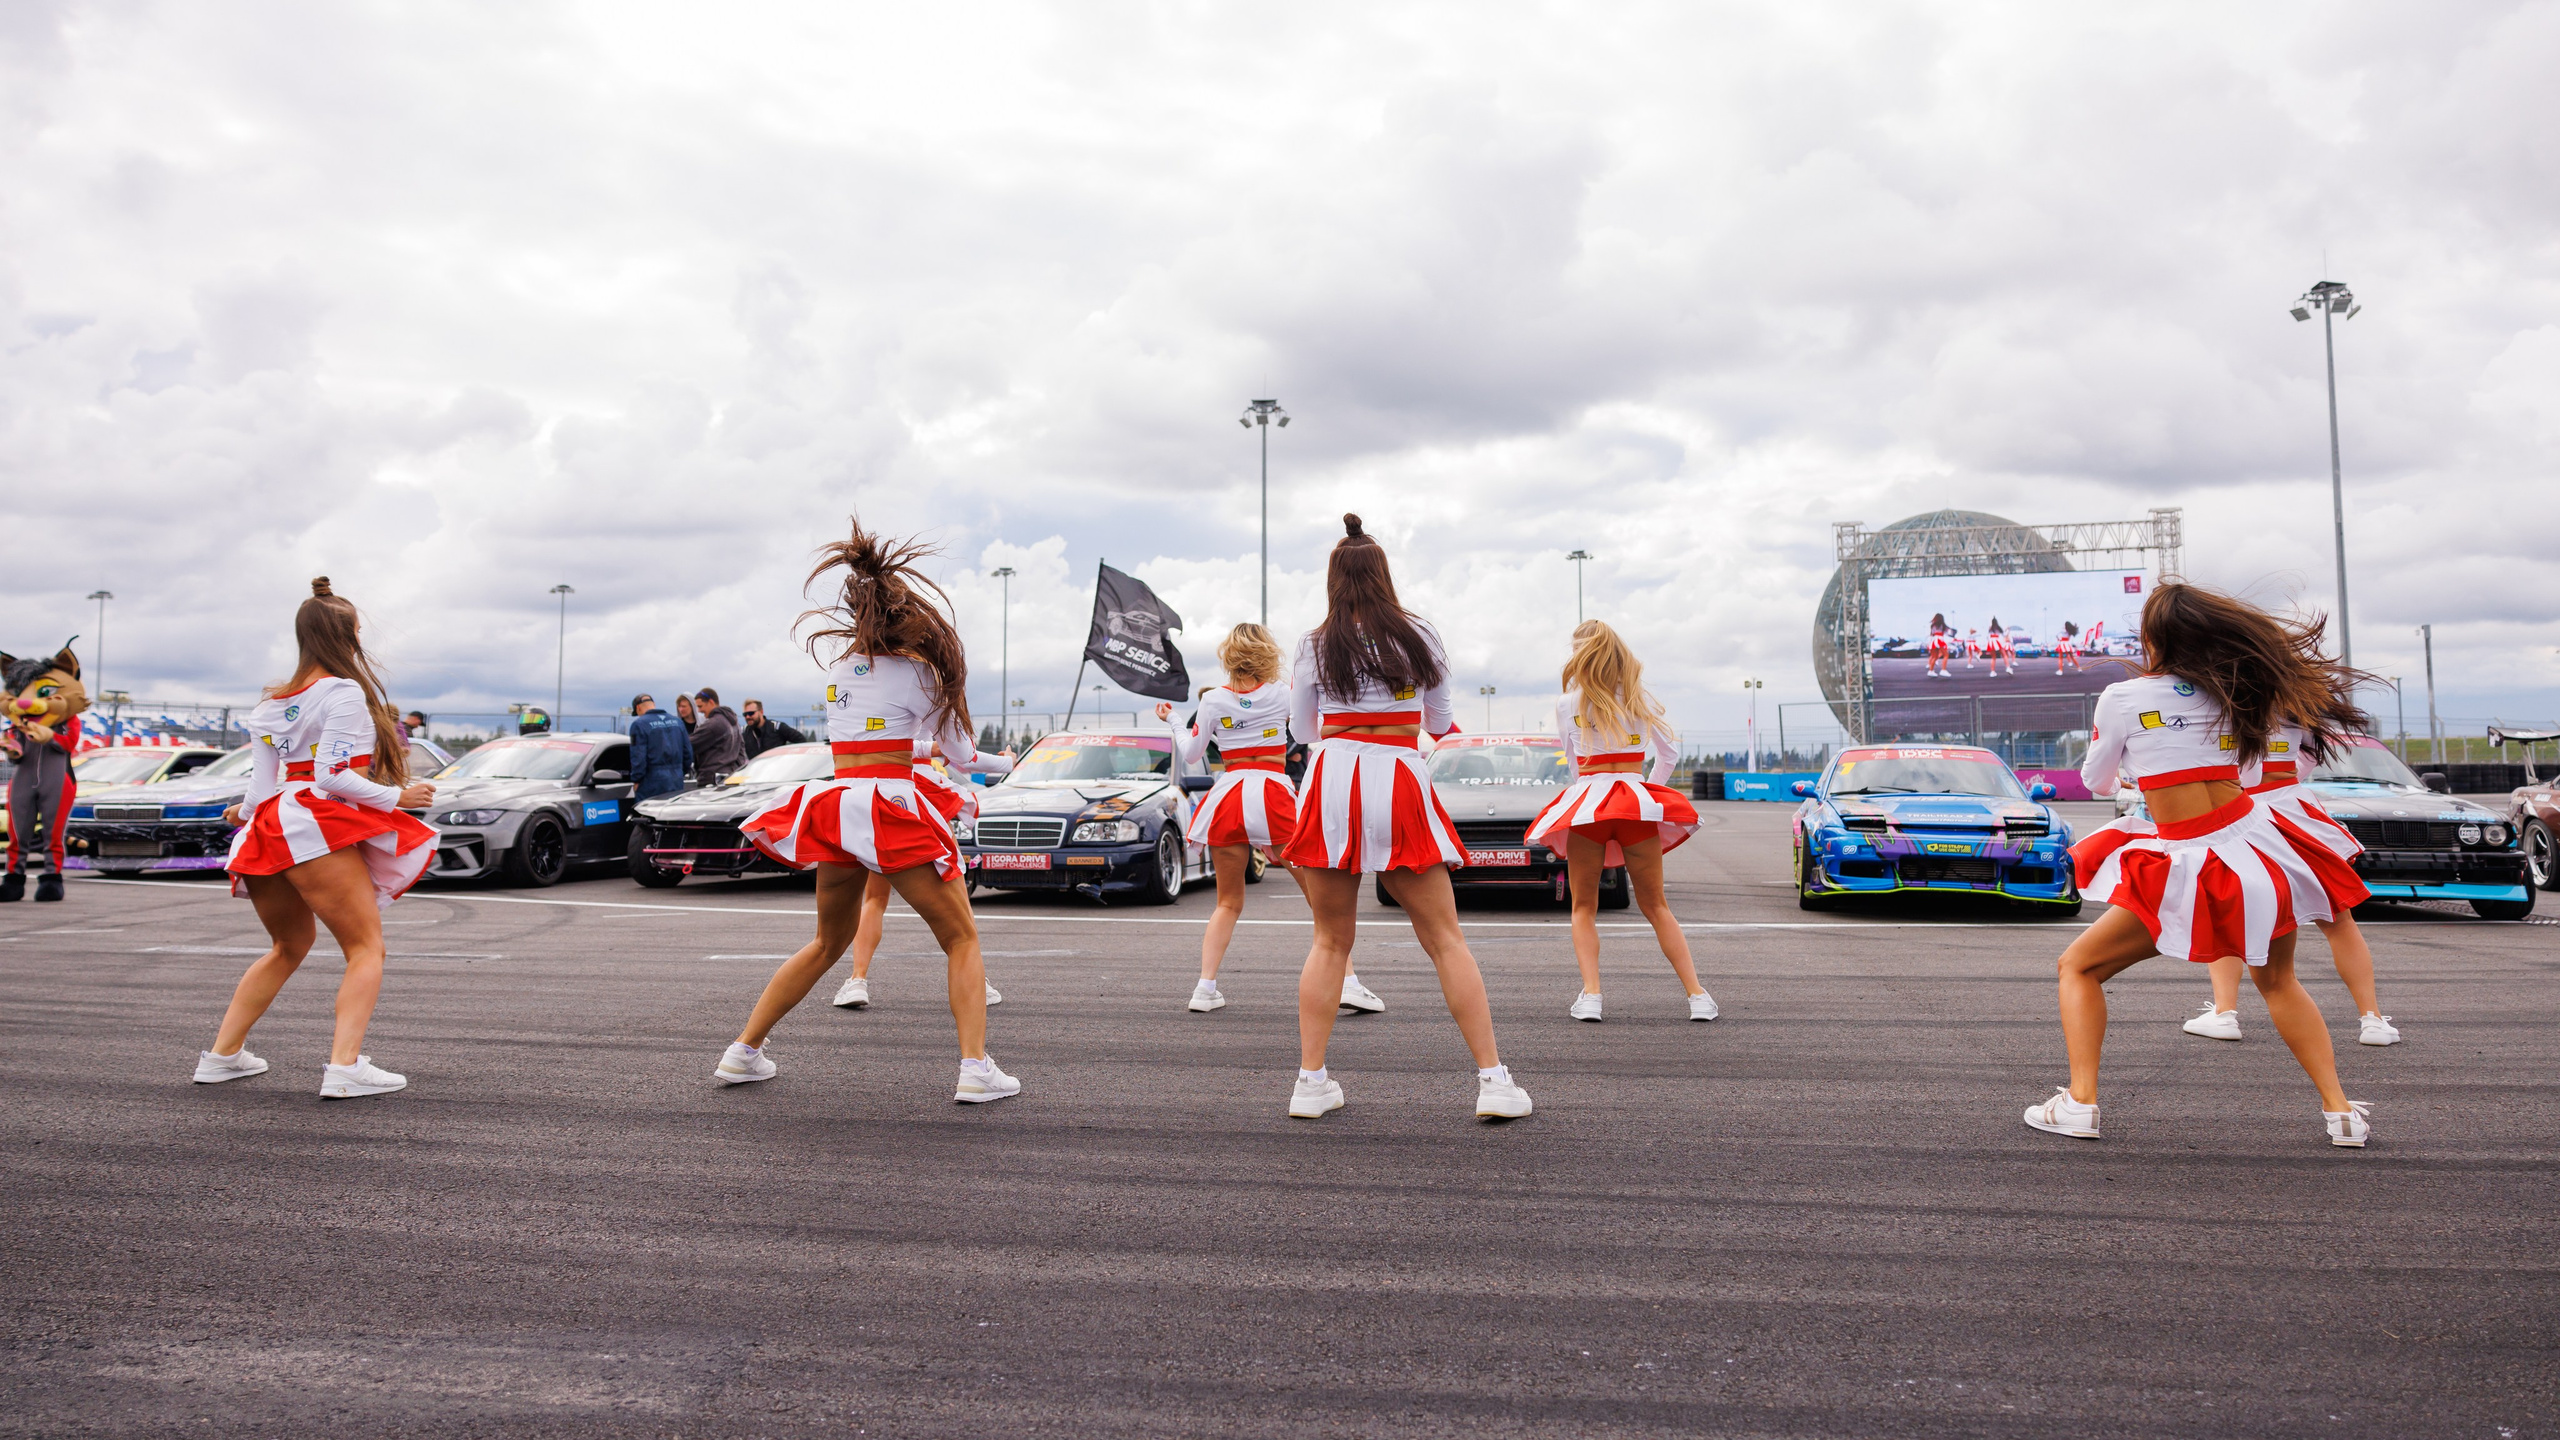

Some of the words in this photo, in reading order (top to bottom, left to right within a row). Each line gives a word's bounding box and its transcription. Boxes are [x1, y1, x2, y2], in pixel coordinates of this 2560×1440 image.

[1483, 737, 1524, 746] IDDC
[1898, 749, 1943, 758] IDDC
[991, 855, 1019, 863] IGORA
[1020, 855, 1047, 863] DRIVE
[1469, 851, 1494, 860] GORA
[1497, 851, 1526, 860] DRIVE
